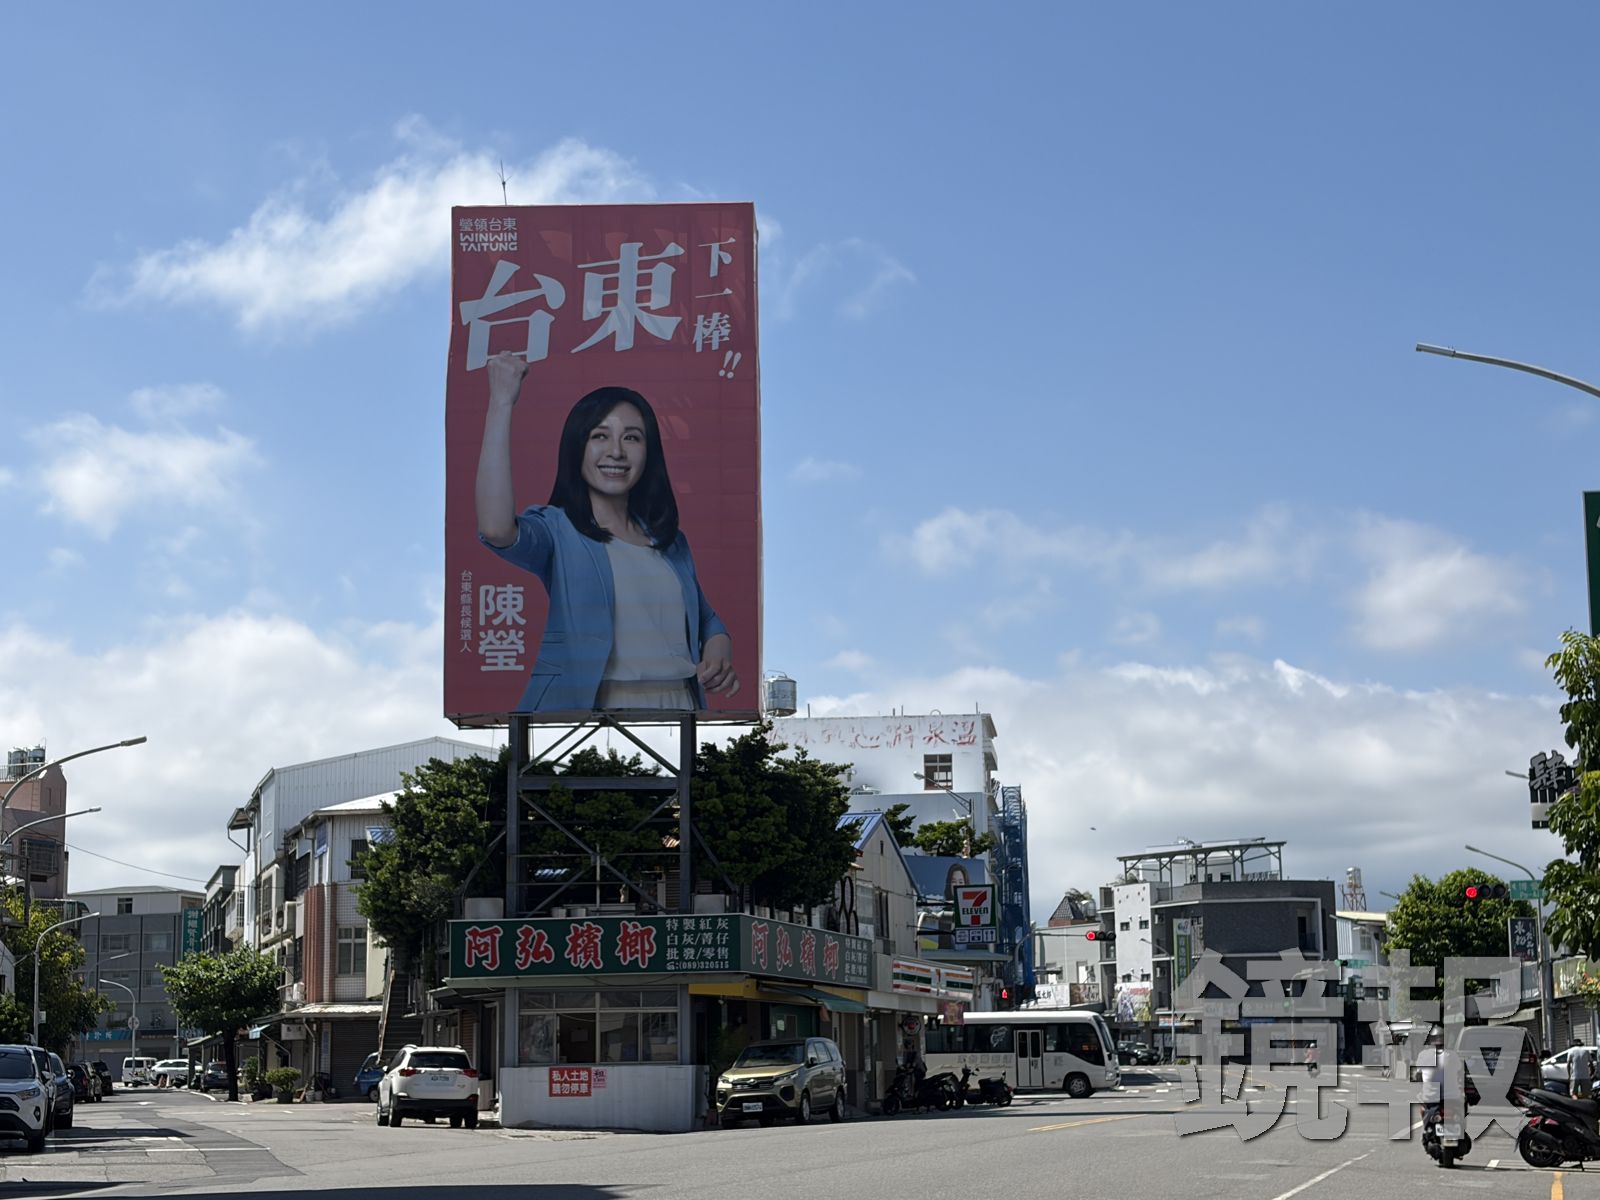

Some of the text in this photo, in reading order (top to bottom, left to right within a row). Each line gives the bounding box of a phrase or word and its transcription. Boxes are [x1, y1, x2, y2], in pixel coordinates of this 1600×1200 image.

[460, 232, 518, 242] WINWIN
[460, 242, 518, 252] TAITUNG
[459, 242, 685, 371] 台東
[460, 570, 472, 653] 台東縣長候選人
[478, 583, 527, 672] 陳瑩
[464, 920, 657, 971] 阿弘檳榔
[751, 920, 840, 980] 阿弘檳榔
[552, 1070, 589, 1081] 私人土地
